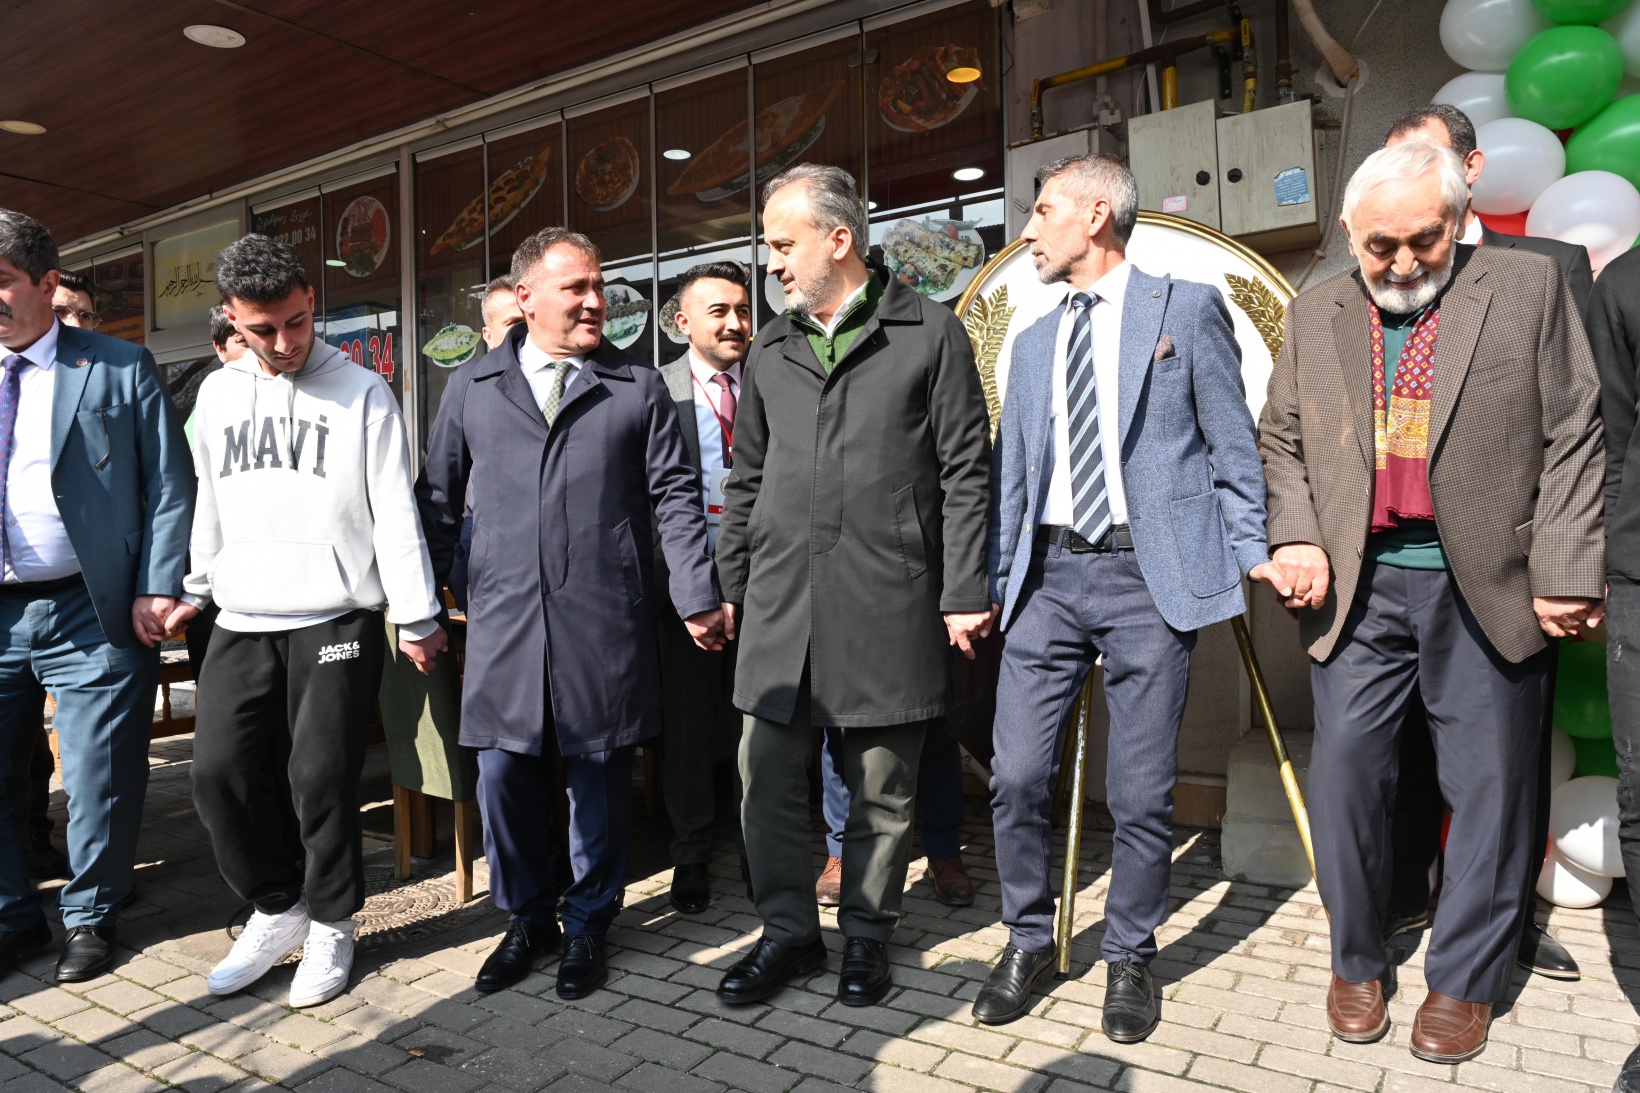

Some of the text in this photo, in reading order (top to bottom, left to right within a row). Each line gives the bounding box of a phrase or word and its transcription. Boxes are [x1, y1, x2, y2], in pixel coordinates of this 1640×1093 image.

[292, 229, 303, 245] 00
[305, 225, 316, 242] 34
[368, 333, 394, 382] 34
[317, 650, 360, 664] JONES
